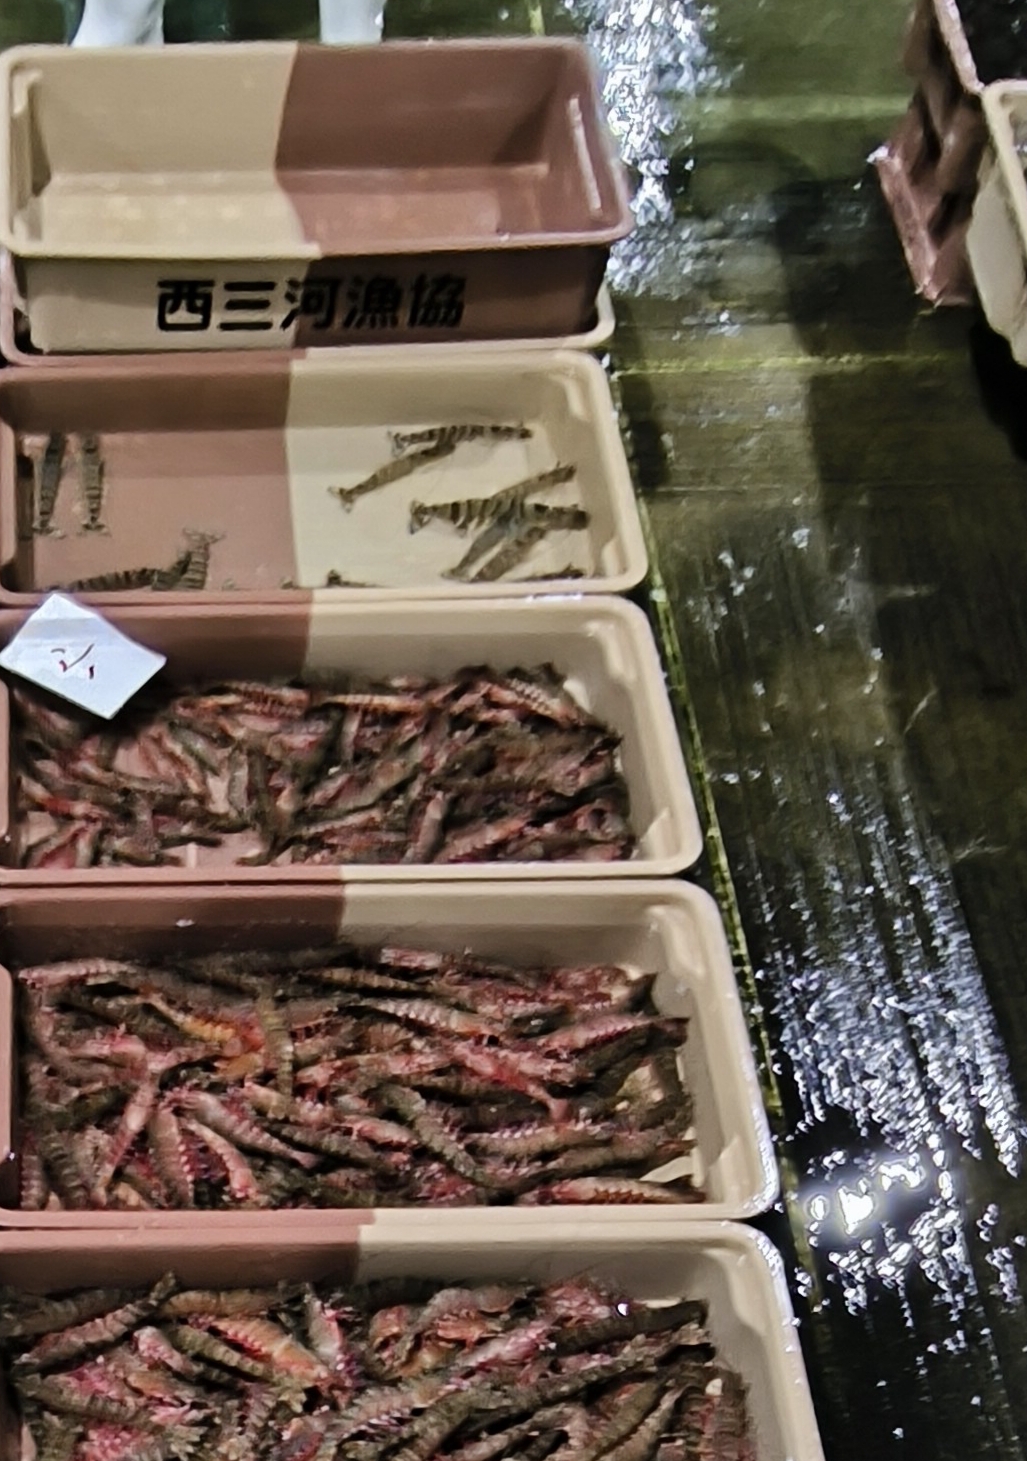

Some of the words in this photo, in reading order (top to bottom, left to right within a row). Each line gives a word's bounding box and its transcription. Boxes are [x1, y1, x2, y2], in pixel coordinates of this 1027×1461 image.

[157, 273, 467, 332] 西三河漁協
